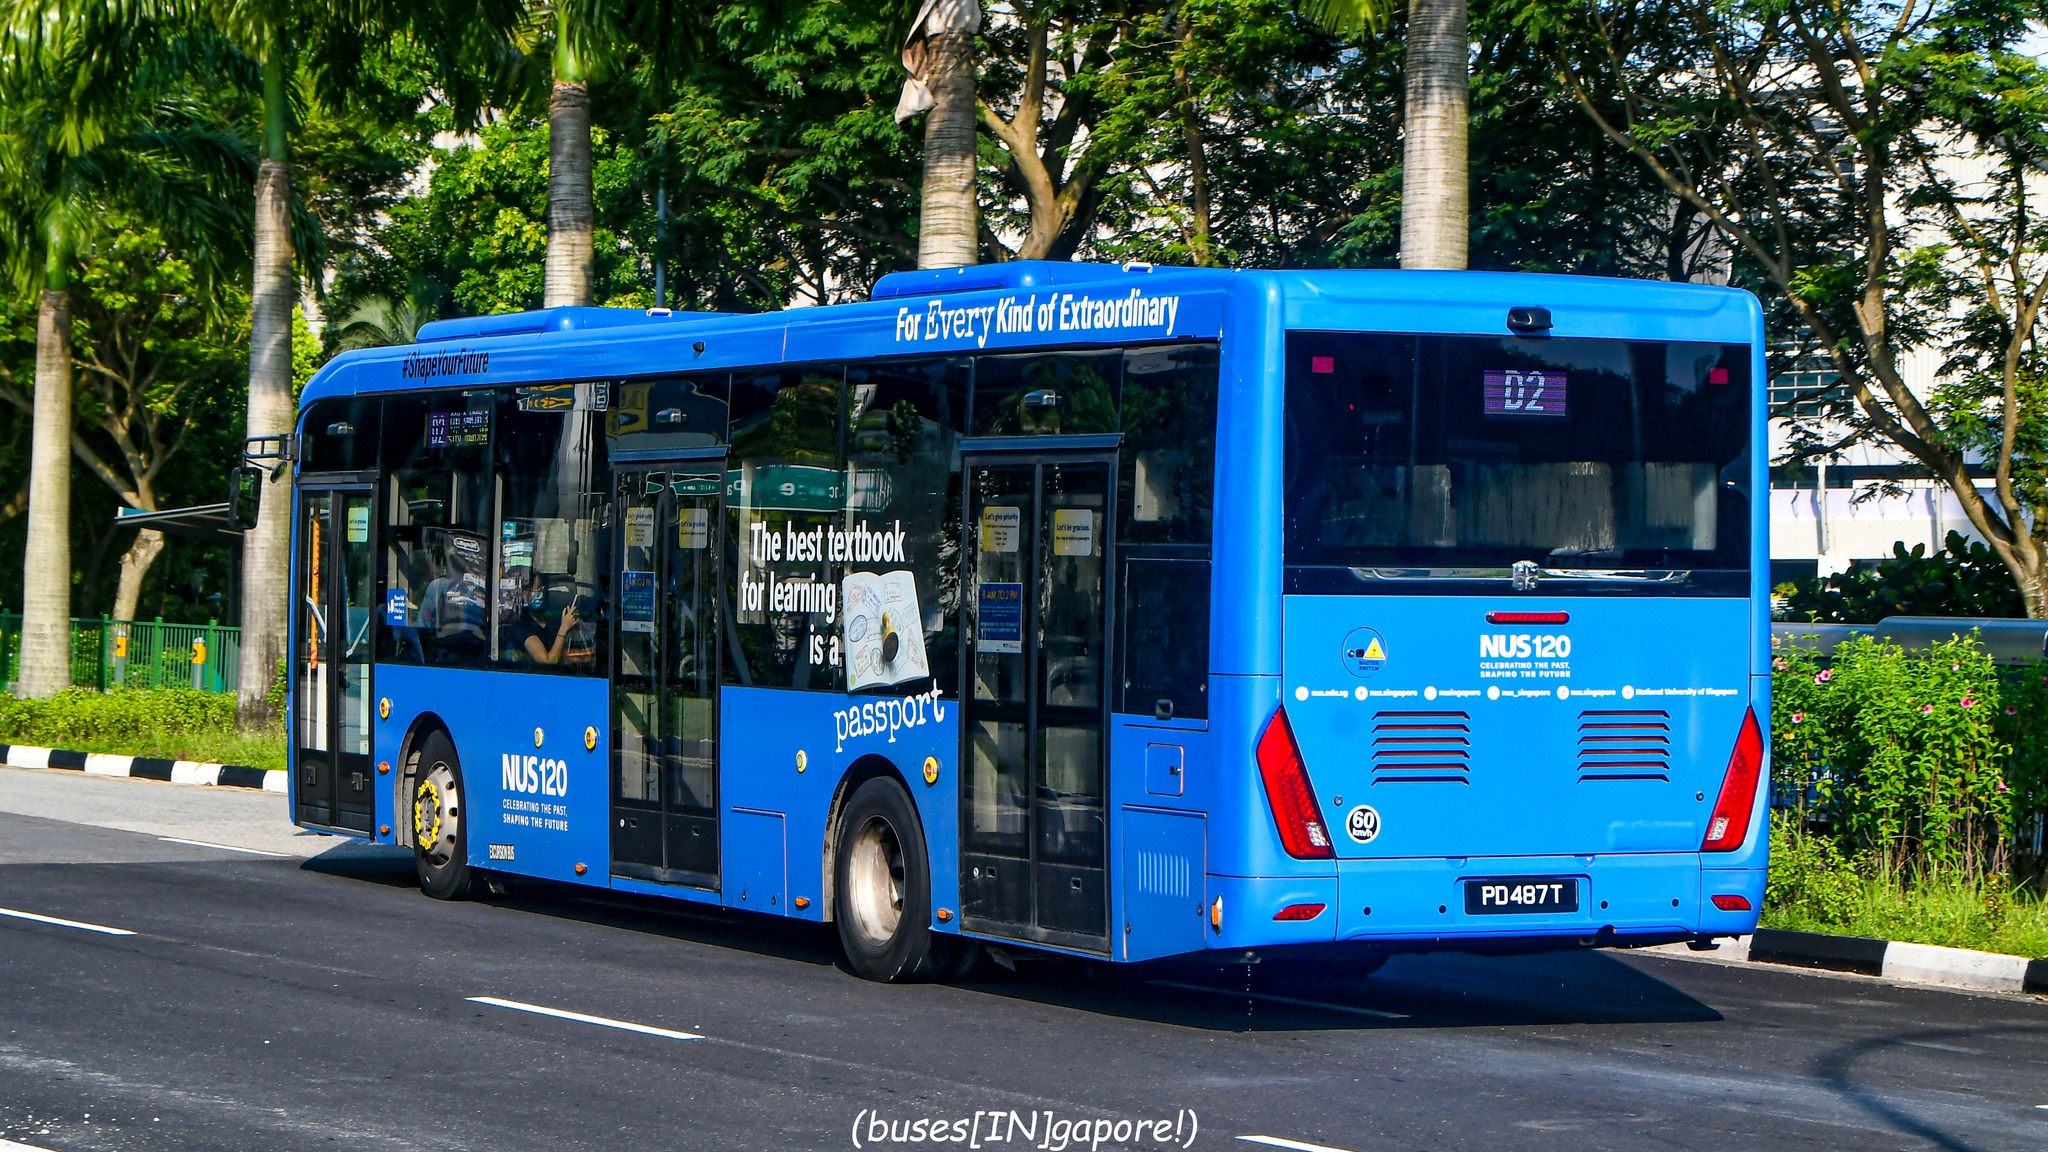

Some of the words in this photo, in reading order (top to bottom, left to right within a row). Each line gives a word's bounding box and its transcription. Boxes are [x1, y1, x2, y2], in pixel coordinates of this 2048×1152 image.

[896, 307, 921, 341] For
[925, 300, 994, 348] Every
[996, 295, 1035, 333] Kind
[1037, 292, 1058, 331] of
[1059, 288, 1179, 336] Extraordinary
[402, 348, 489, 384] #ShapeYourFuture
[1504, 369, 1546, 411] D2
[750, 520, 782, 562] The
[786, 520, 823, 563] best
[827, 519, 906, 563] textbook
[741, 570, 765, 612] for
[769, 570, 836, 624] learning
[809, 624, 824, 665] is
[828, 635, 839, 666] a
[1480, 634, 1571, 658] NUS120
[1635, 688, 1663, 696] National
[1664, 688, 1697, 697] University
[1705, 688, 1738, 697] Singapore
[833, 677, 945, 753] passport
[502, 753, 568, 797] NUS120
[503, 799, 539, 813] CELEBRATING
[541, 803, 551, 815] THE
[503, 813, 528, 826] SHAPING
[531, 817, 542, 828] THE
[544, 819, 568, 831] FUTURE
[1352, 810, 1375, 828] 60
[1352, 828, 1373, 838] km/h
[1481, 884, 1563, 906] PD487T
